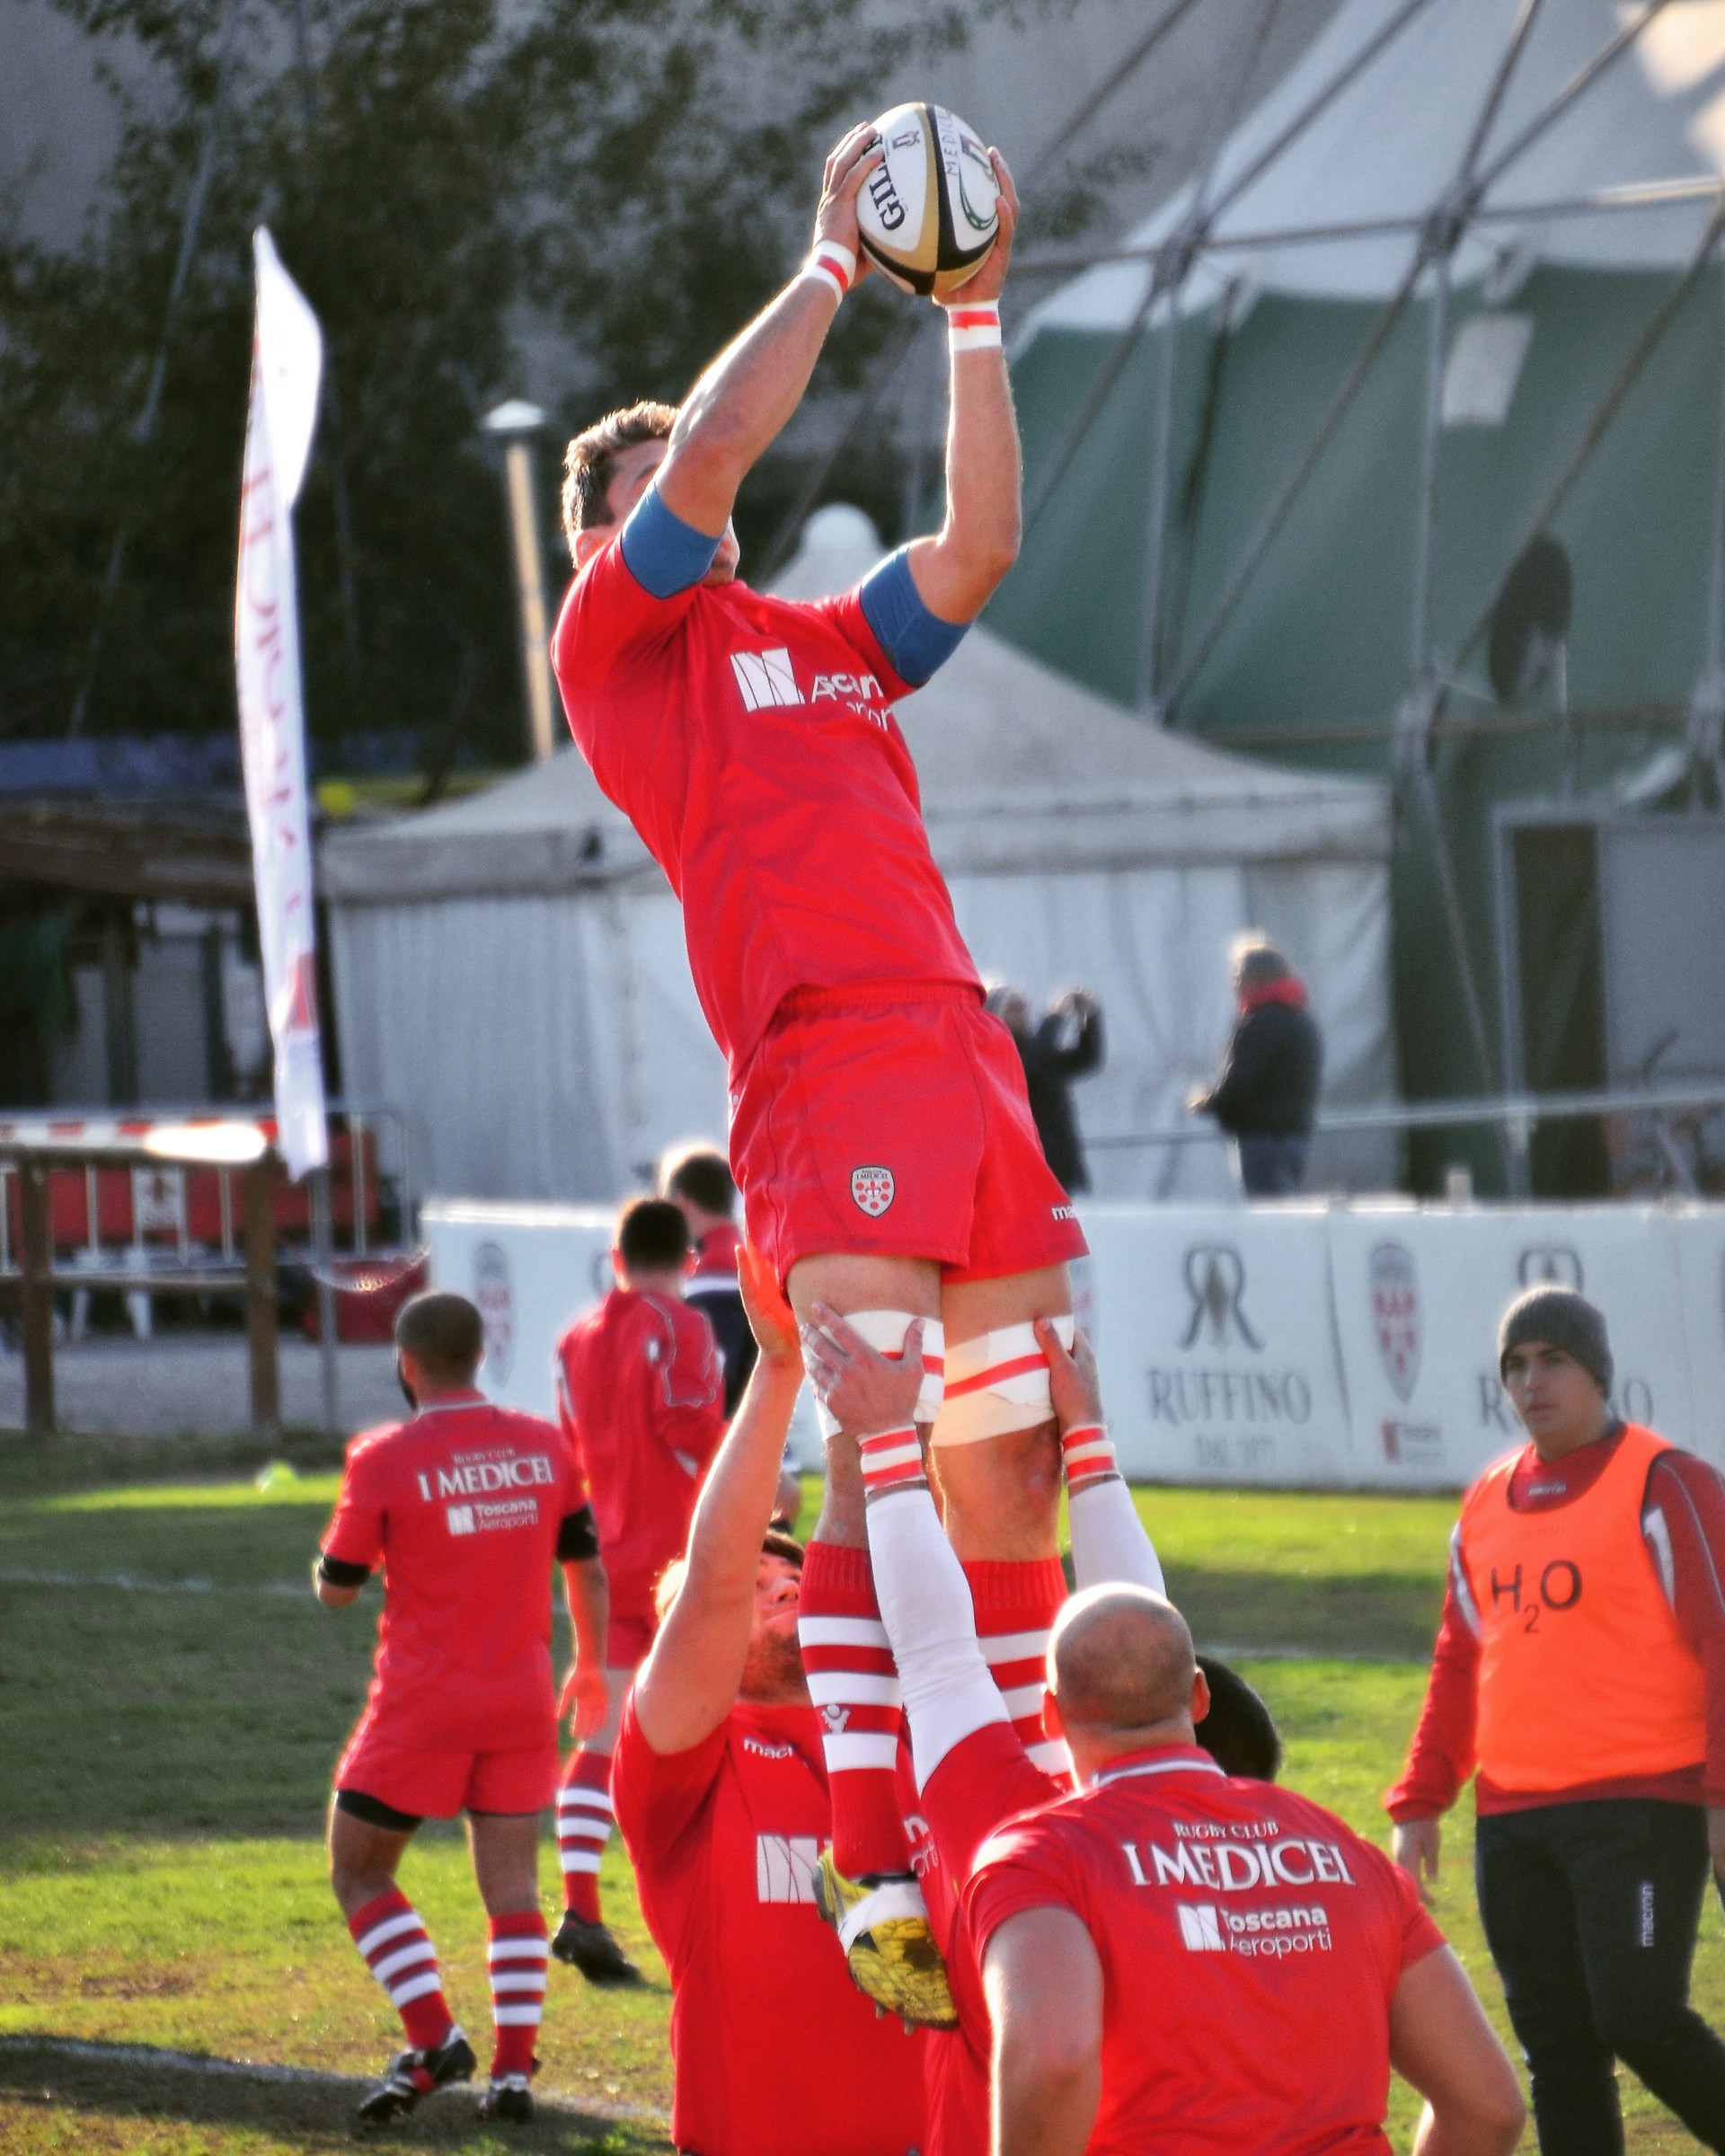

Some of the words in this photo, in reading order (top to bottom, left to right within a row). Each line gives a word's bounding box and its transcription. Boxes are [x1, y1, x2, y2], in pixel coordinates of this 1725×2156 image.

[1147, 1367, 1312, 1427] RUFFINO
[438, 1457, 553, 1498] MEDICEI
[475, 1500, 536, 1517] Toscana
[1173, 1822, 1226, 1839] RUGBY
[1231, 1821, 1279, 1839] CLUB
[1121, 1842, 1151, 1886] I
[1151, 1840, 1357, 1892] MEDICEI
